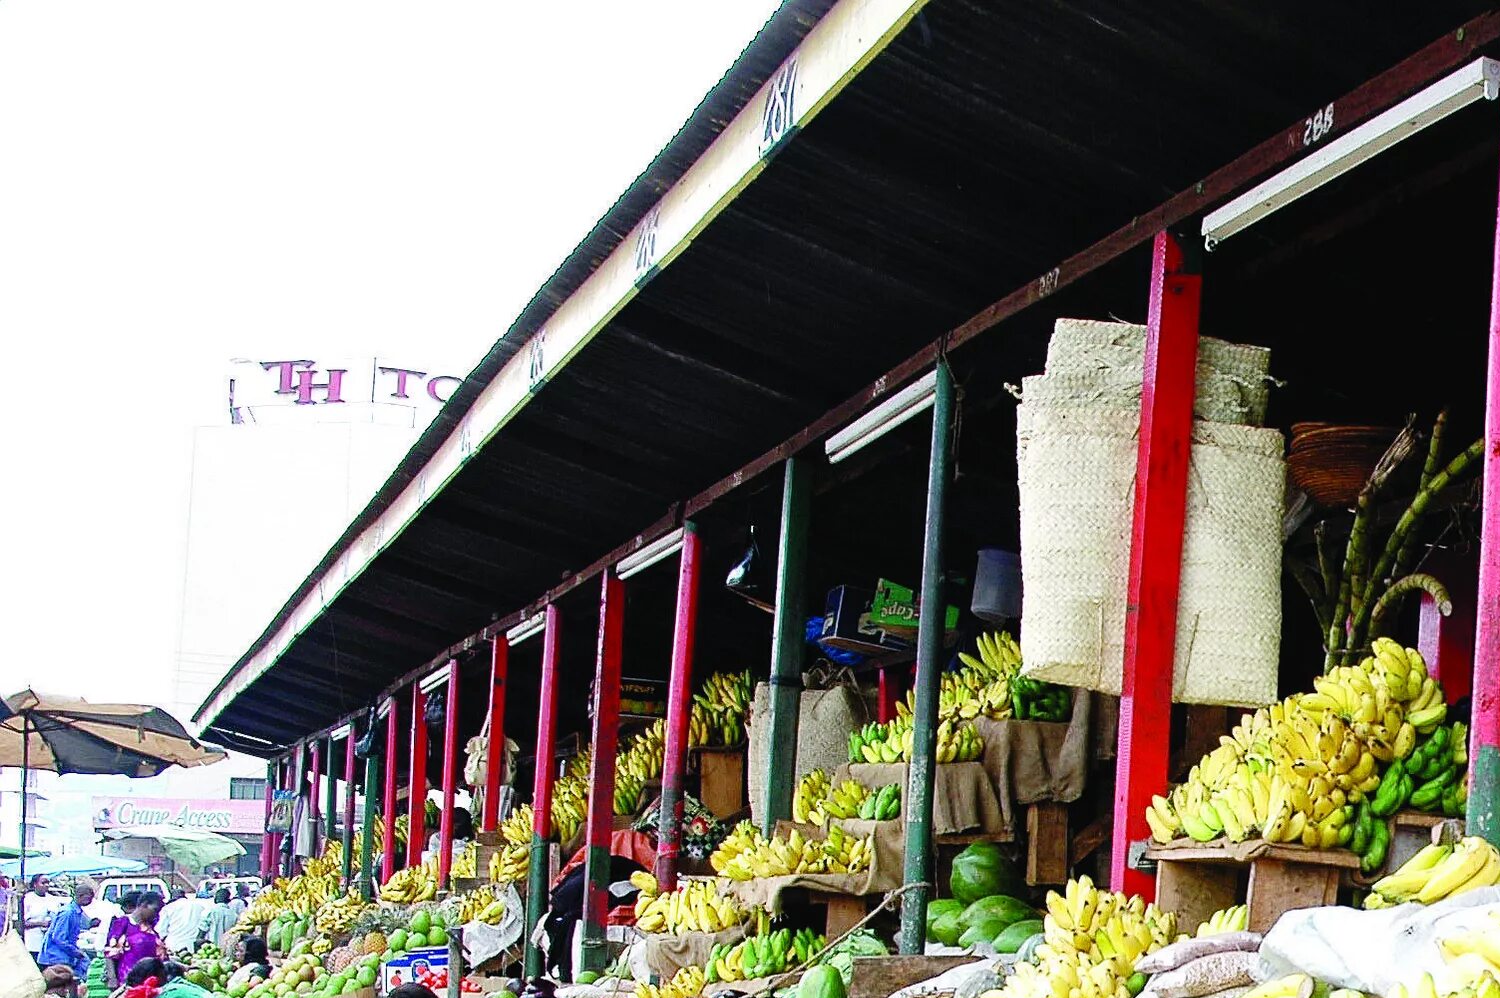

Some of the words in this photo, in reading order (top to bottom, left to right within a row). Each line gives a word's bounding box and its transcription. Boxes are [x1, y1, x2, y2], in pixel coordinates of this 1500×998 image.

[1303, 102, 1335, 146] 288
[259, 360, 348, 405] TH
[118, 803, 170, 825] Crane
[170, 806, 232, 828] Access
